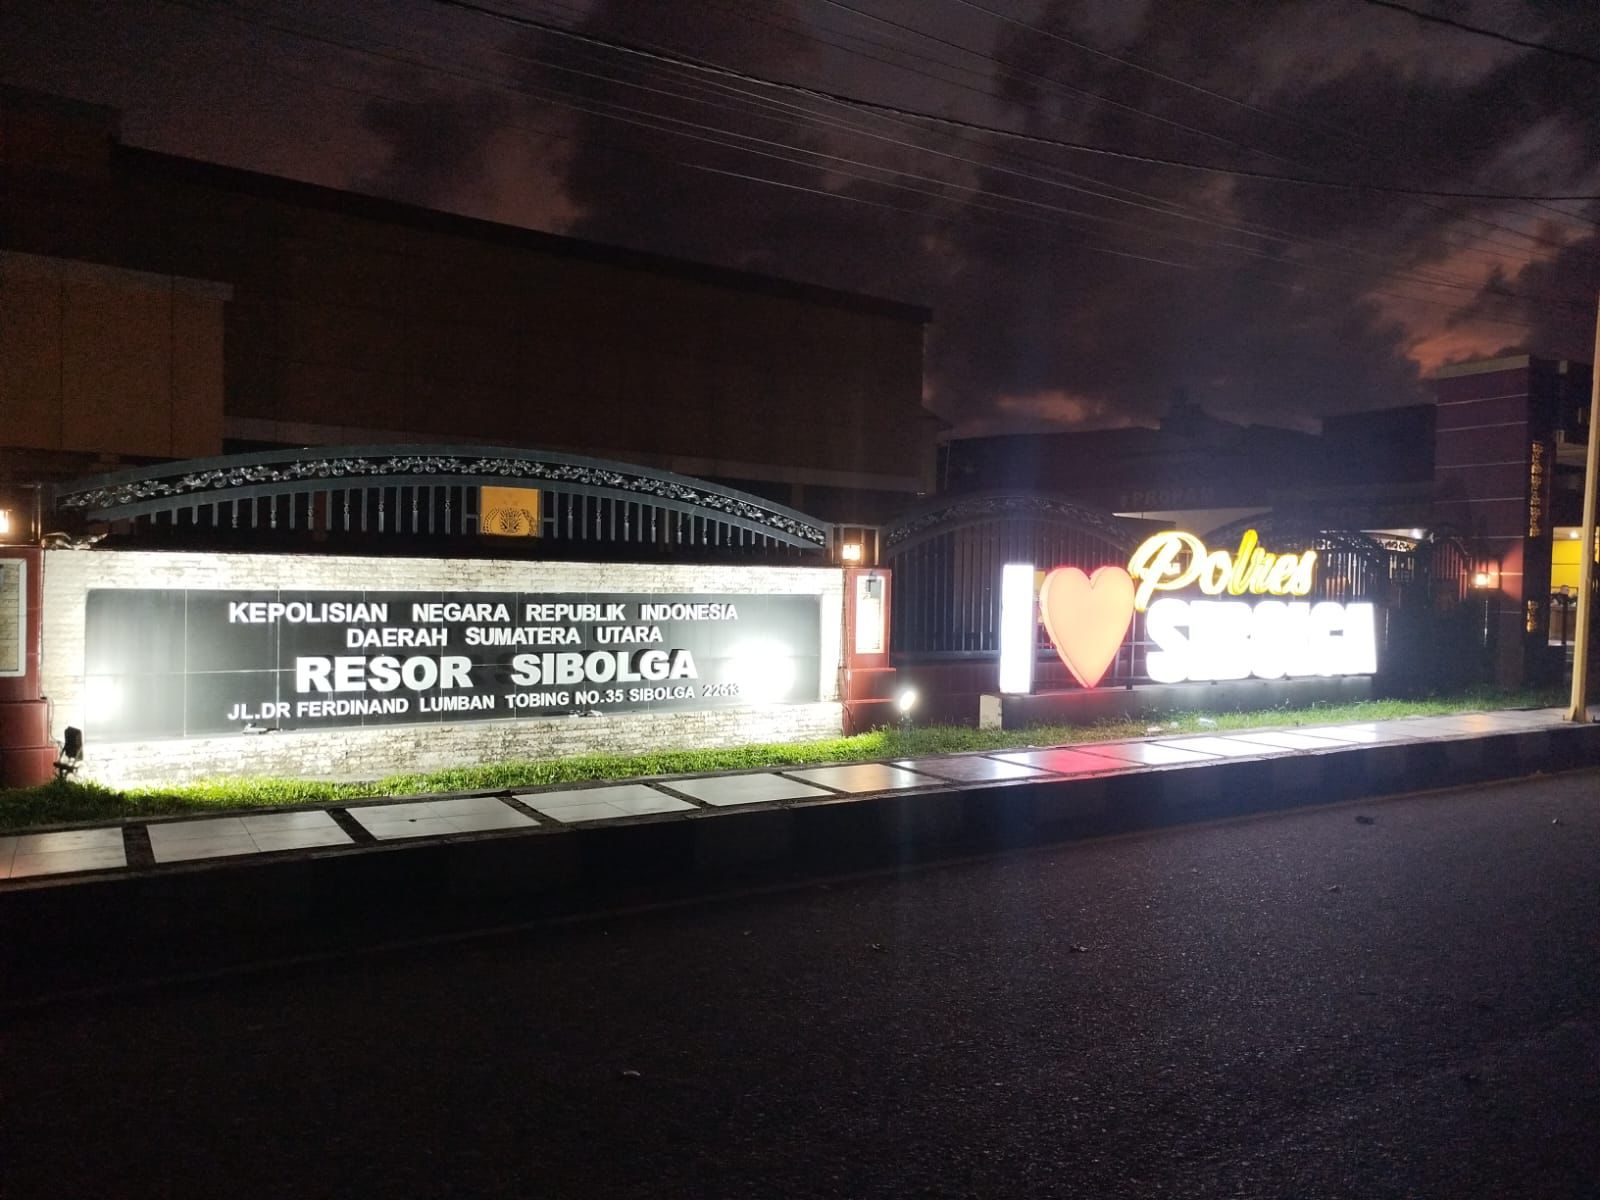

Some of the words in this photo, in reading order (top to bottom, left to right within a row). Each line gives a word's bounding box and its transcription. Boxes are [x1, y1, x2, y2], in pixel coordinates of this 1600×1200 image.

[1128, 529, 1318, 612] Polres
[229, 602, 387, 623] KEPOLISIAN
[413, 603, 509, 622] NEGARA
[526, 604, 625, 621] REPUBLIK
[642, 604, 738, 620] INDONESIA
[1000, 564, 1034, 693] I
[347, 628, 447, 647] DAERAH
[465, 627, 581, 645] SUMATERA
[597, 626, 663, 643] UTARA
[296, 656, 473, 692] RESOR
[511, 650, 698, 686] SIBOLGA
[297, 698, 408, 717] FERDINAND
[420, 695, 494, 712] LUMBAN
[505, 691, 569, 708] TOBING
[575, 689, 624, 705] NO.35
[629, 686, 695, 701] SIBOLGA
